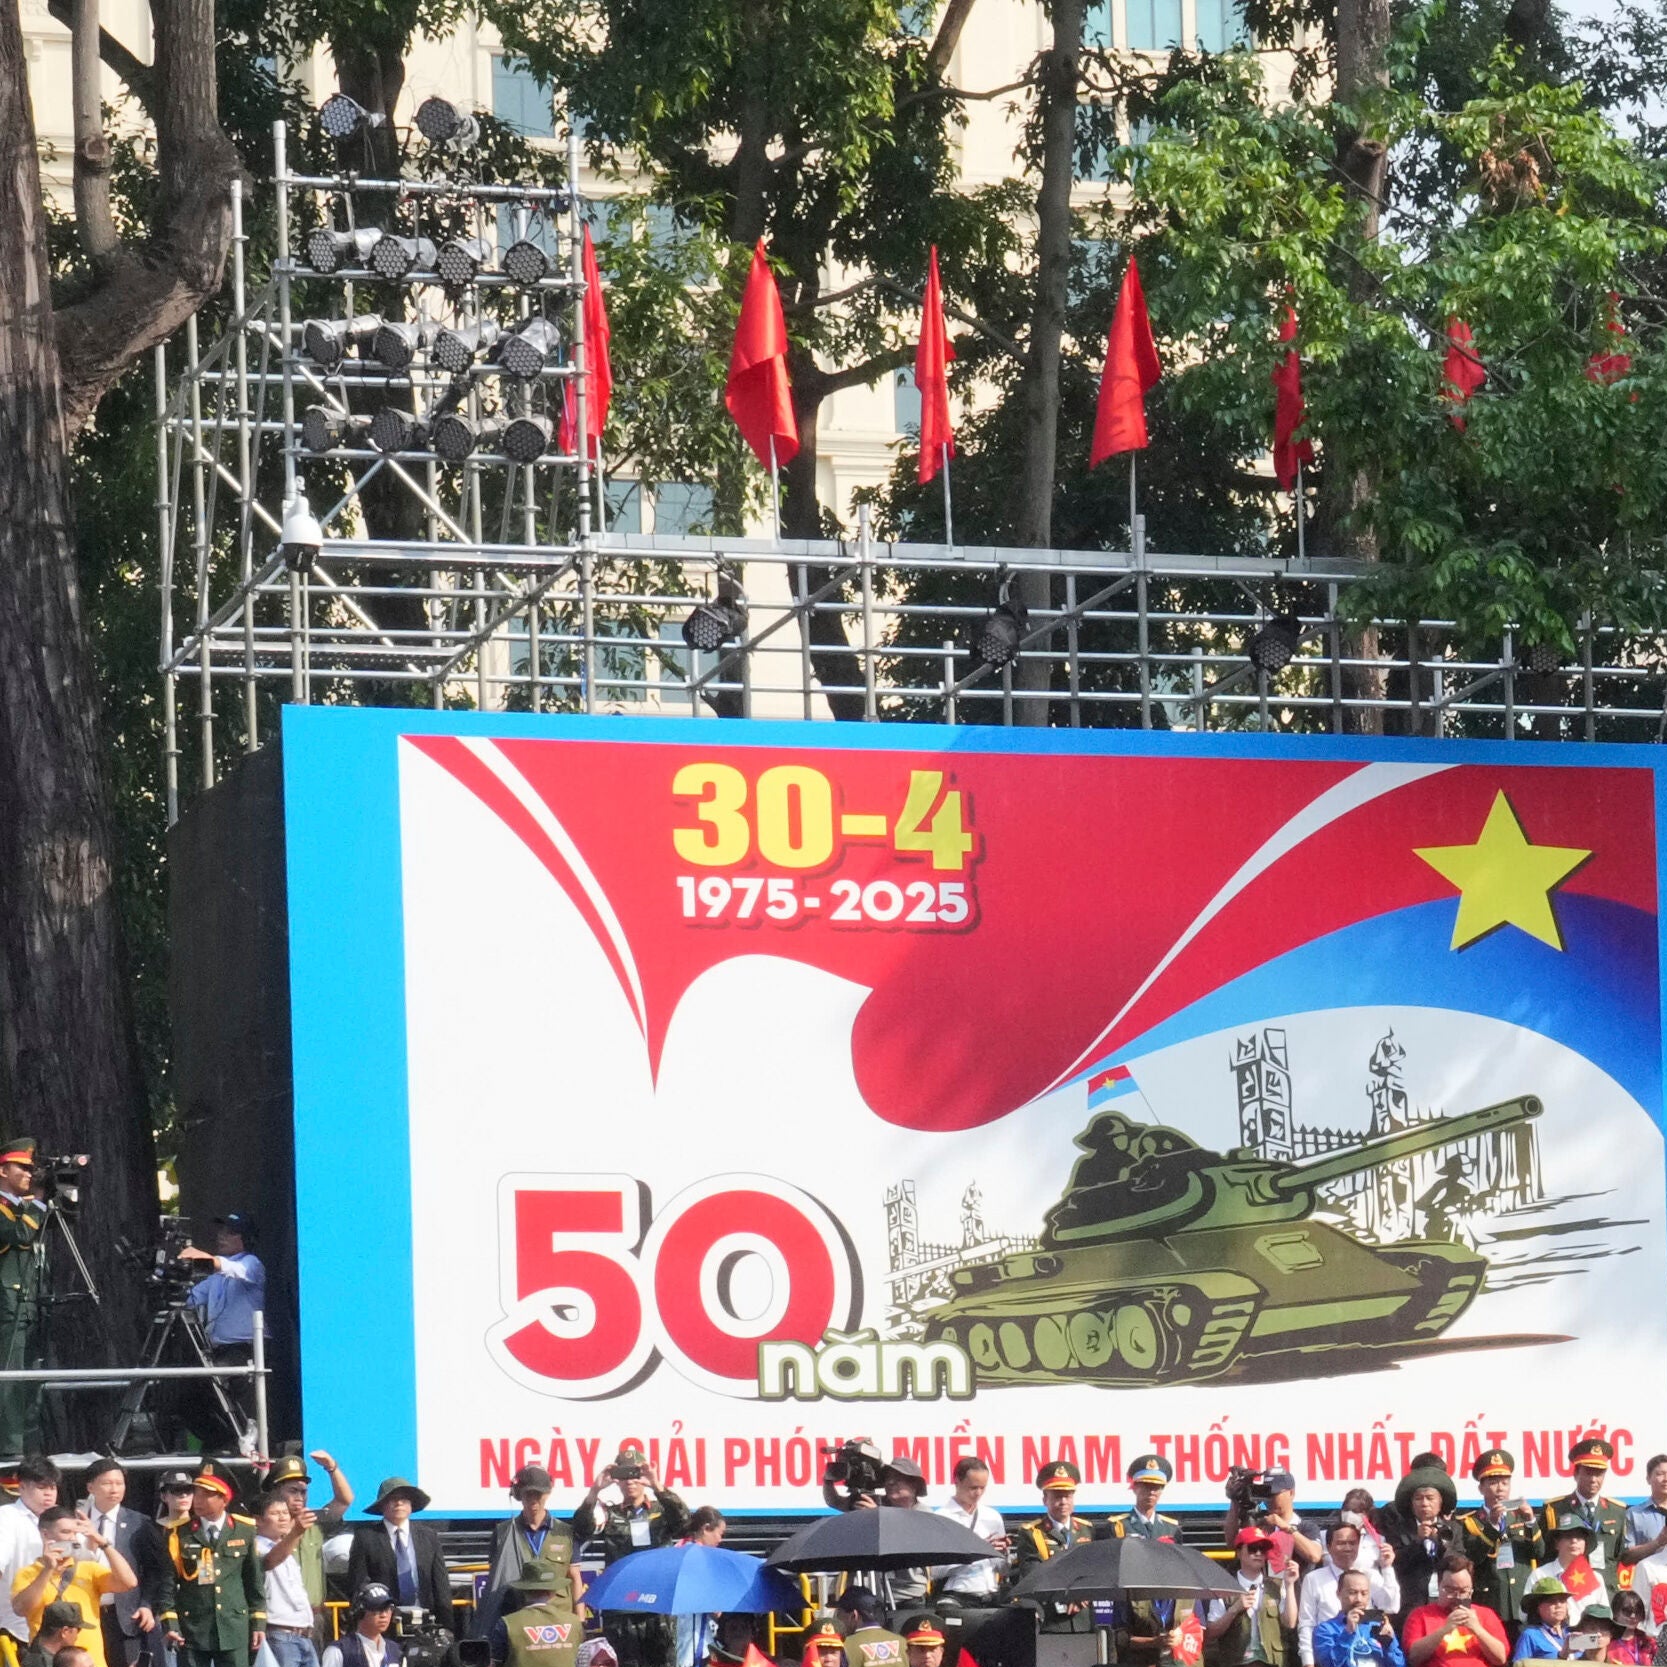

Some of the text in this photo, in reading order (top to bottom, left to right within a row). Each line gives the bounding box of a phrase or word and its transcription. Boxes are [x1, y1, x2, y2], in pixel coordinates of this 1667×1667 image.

[671, 762, 973, 870] 30-4
[501, 1186, 840, 1384] 50
[759, 1329, 975, 1399] năm
[480, 1426, 601, 1488] NGÀY
[619, 1420, 706, 1488] IẢI
[1307, 1414, 1416, 1481] NHẤT
[1522, 1419, 1635, 1479] NƯC
[523, 1624, 573, 1644] VOV
[859, 1640, 900, 1660] VOV
